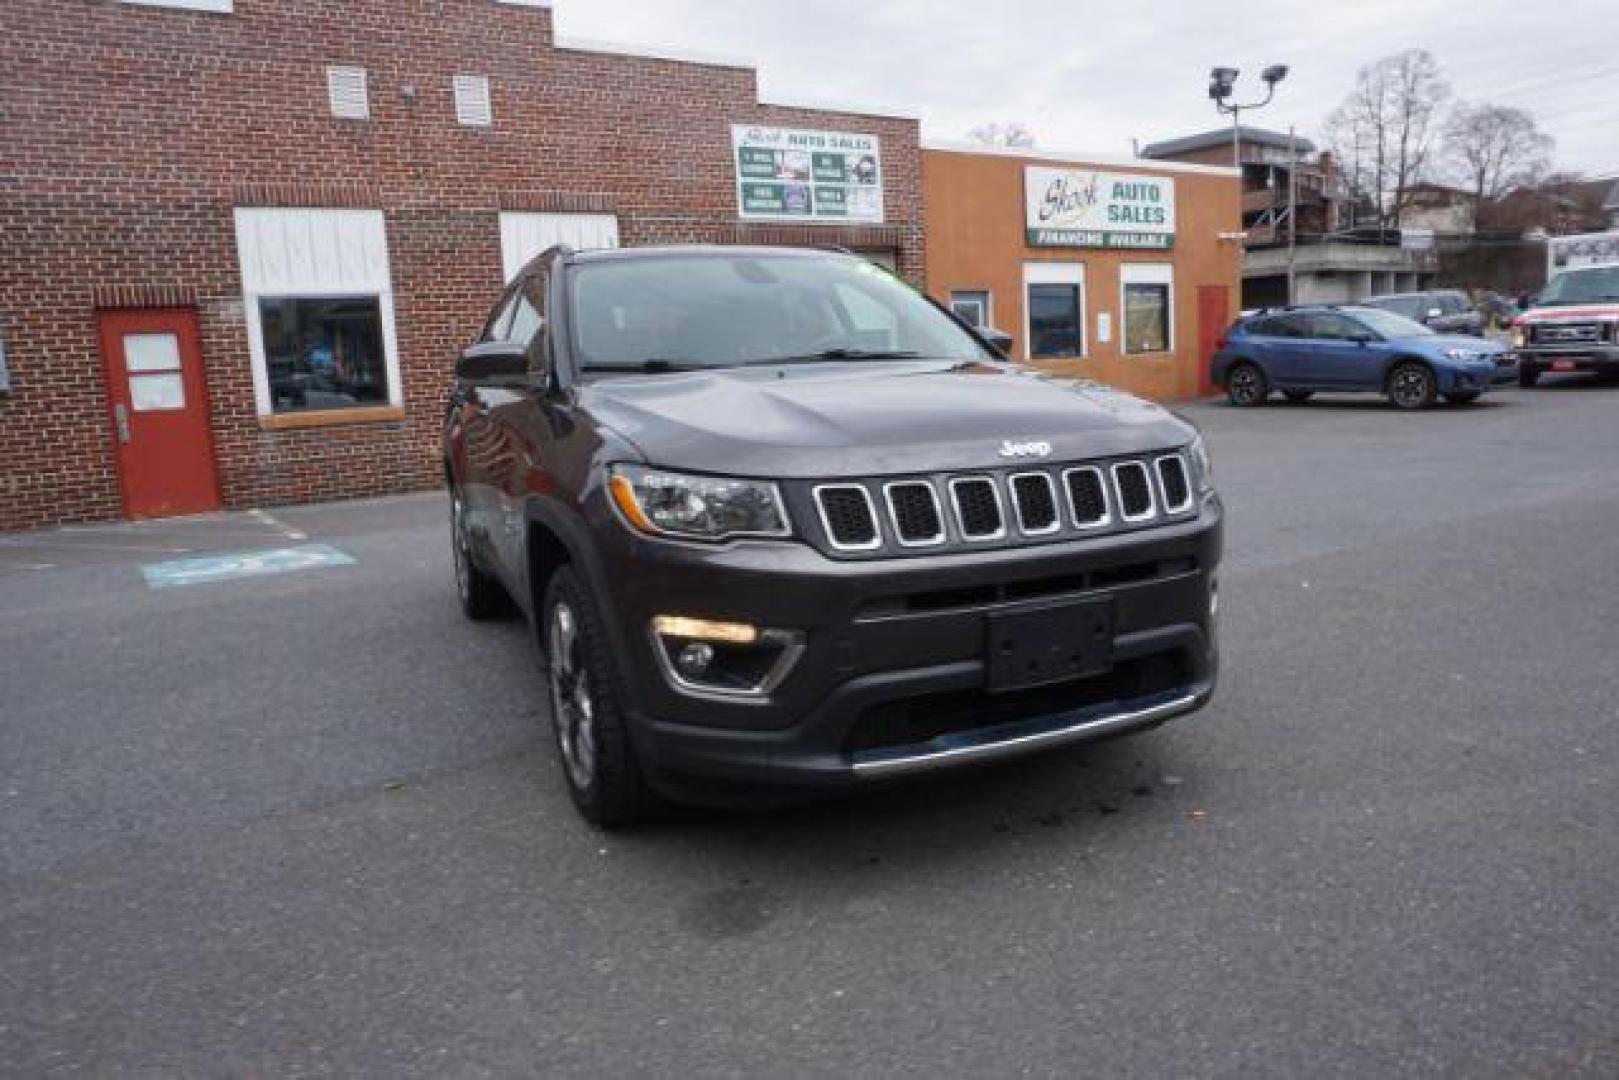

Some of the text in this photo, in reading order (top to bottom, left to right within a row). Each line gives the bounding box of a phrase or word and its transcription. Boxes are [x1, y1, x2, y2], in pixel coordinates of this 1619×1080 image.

[1112, 181, 1160, 203] AUTO
[1107, 204, 1166, 224] SALES
[999, 439, 1052, 456] Jeep
